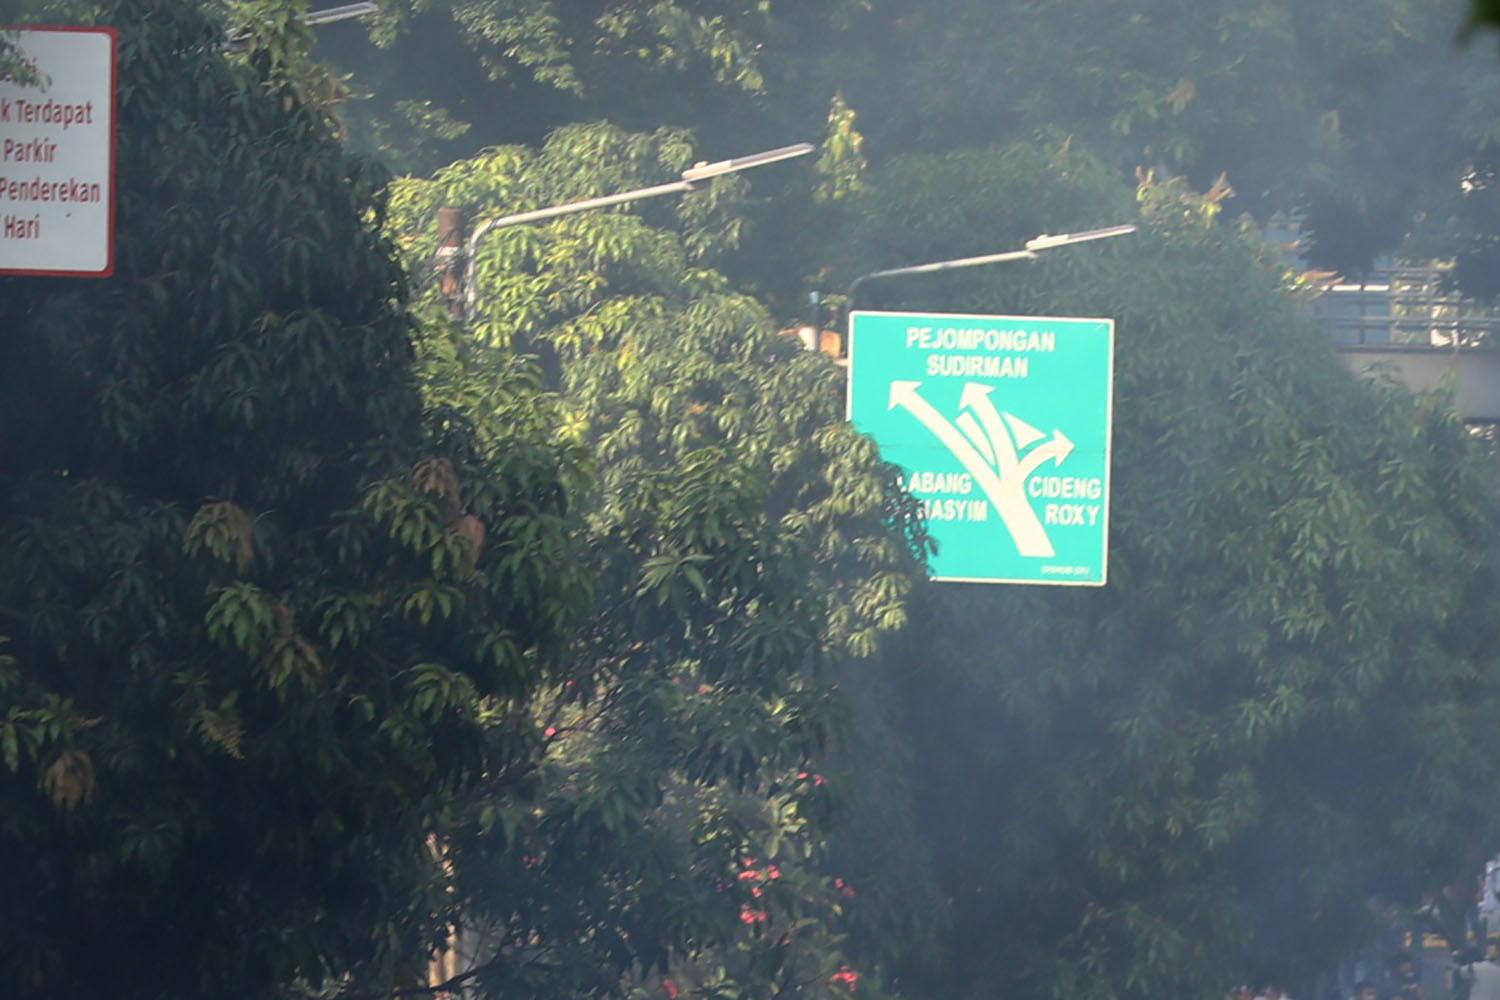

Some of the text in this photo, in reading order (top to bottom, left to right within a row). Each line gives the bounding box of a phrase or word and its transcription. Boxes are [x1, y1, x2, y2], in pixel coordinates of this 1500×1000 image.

[16, 98, 93, 130] Terdapat
[4, 137, 58, 162] Parkir
[0, 176, 101, 203] Penderekan
[4, 213, 41, 239] Hari
[906, 327, 1056, 352] PEJOMPONGAN
[926, 354, 1029, 378] SUDIRMAN
[908, 472, 972, 494] ABANG
[1029, 476, 1101, 499] CIDENG
[1045, 504, 1100, 526] ROXY
